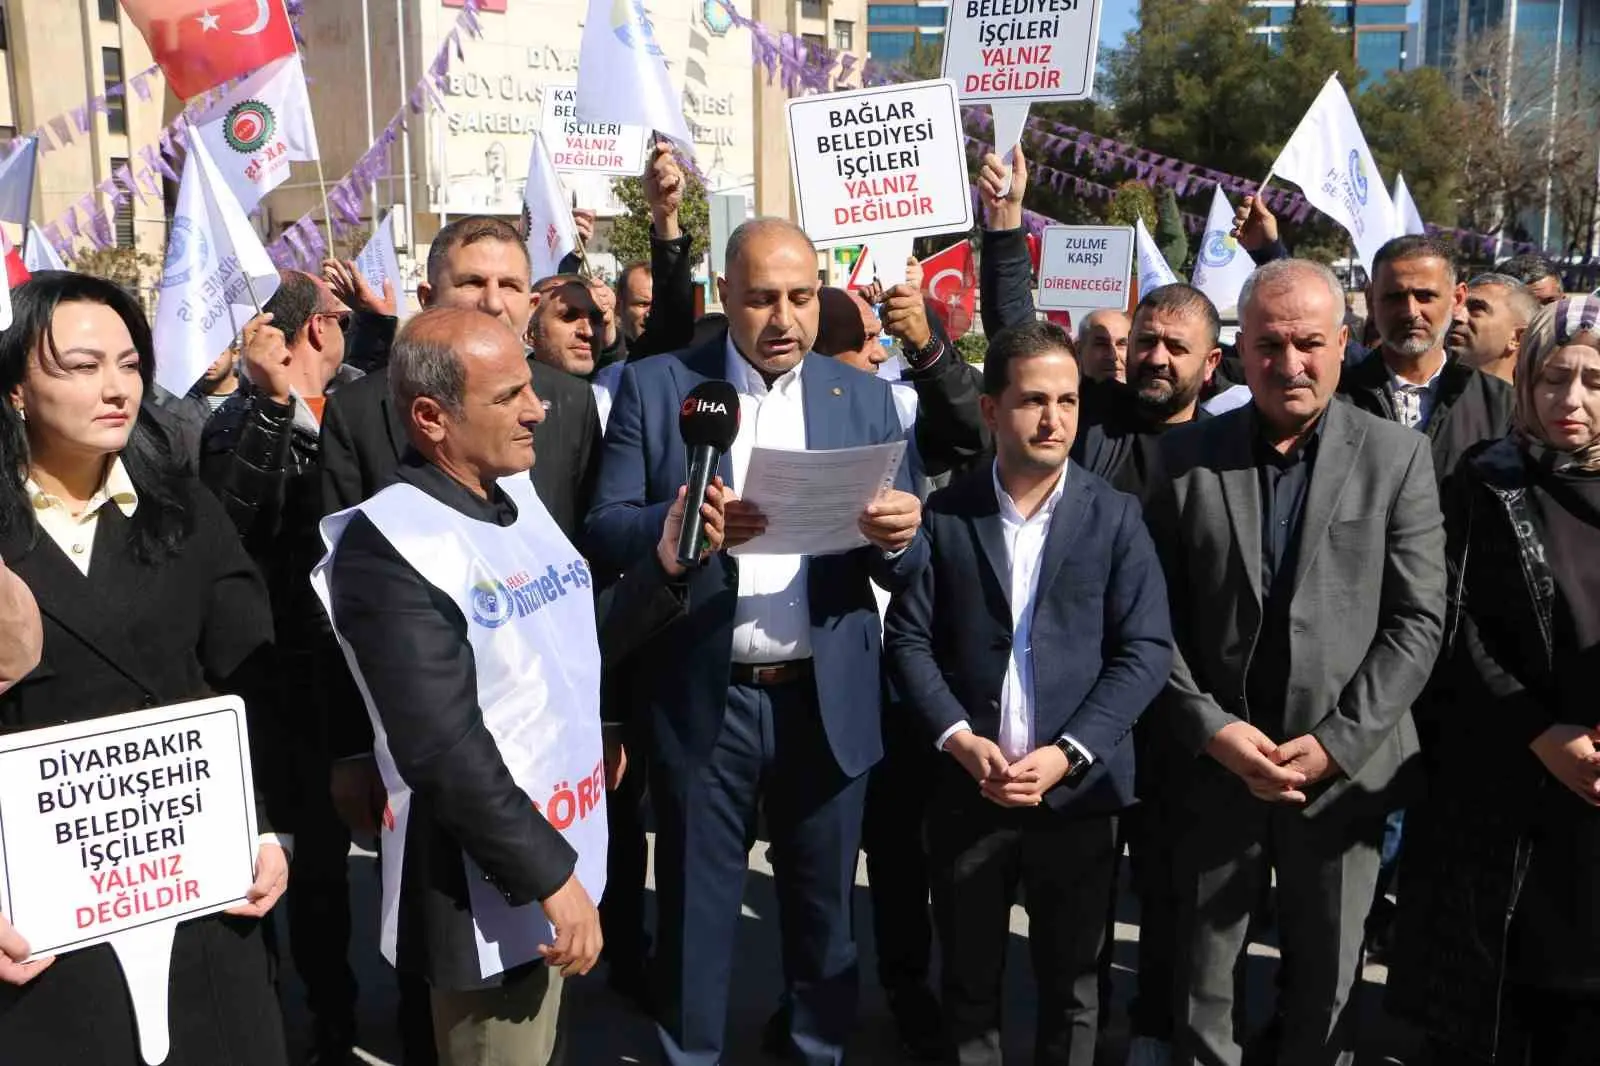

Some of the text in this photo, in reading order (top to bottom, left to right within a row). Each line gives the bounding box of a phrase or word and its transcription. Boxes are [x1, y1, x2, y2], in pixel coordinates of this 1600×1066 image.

[979, 15, 1060, 46] İŞÇİLERİ
[981, 45, 1052, 66] YALNIZ
[965, 67, 1061, 92] DEĞİLDİR
[829, 101, 915, 128] BAĞLAR
[566, 138, 616, 151] YALNIZ
[817, 118, 934, 153] BELEDİYESİ
[554, 151, 623, 167] DEĞİLDİR
[836, 145, 920, 179] İŞÇİLERİ
[845, 174, 919, 199] YALNIZ
[834, 194, 934, 225] DEĞİLDİR
[1066, 238, 1108, 249] ZULME
[1068, 253, 1103, 267] KARŞI
[1044, 276, 1122, 291] DİRENECEĞİZ
[39, 729, 203, 780] DİYARBAKIR
[37, 757, 211, 814] BÜYÜKŞEHİR
[55, 787, 203, 844] BELEDİYESİ
[80, 820, 185, 871] İŞÇİLERİ
[90, 854, 184, 894] YALNIZ
[75, 879, 201, 928] DEĞİLDİR
